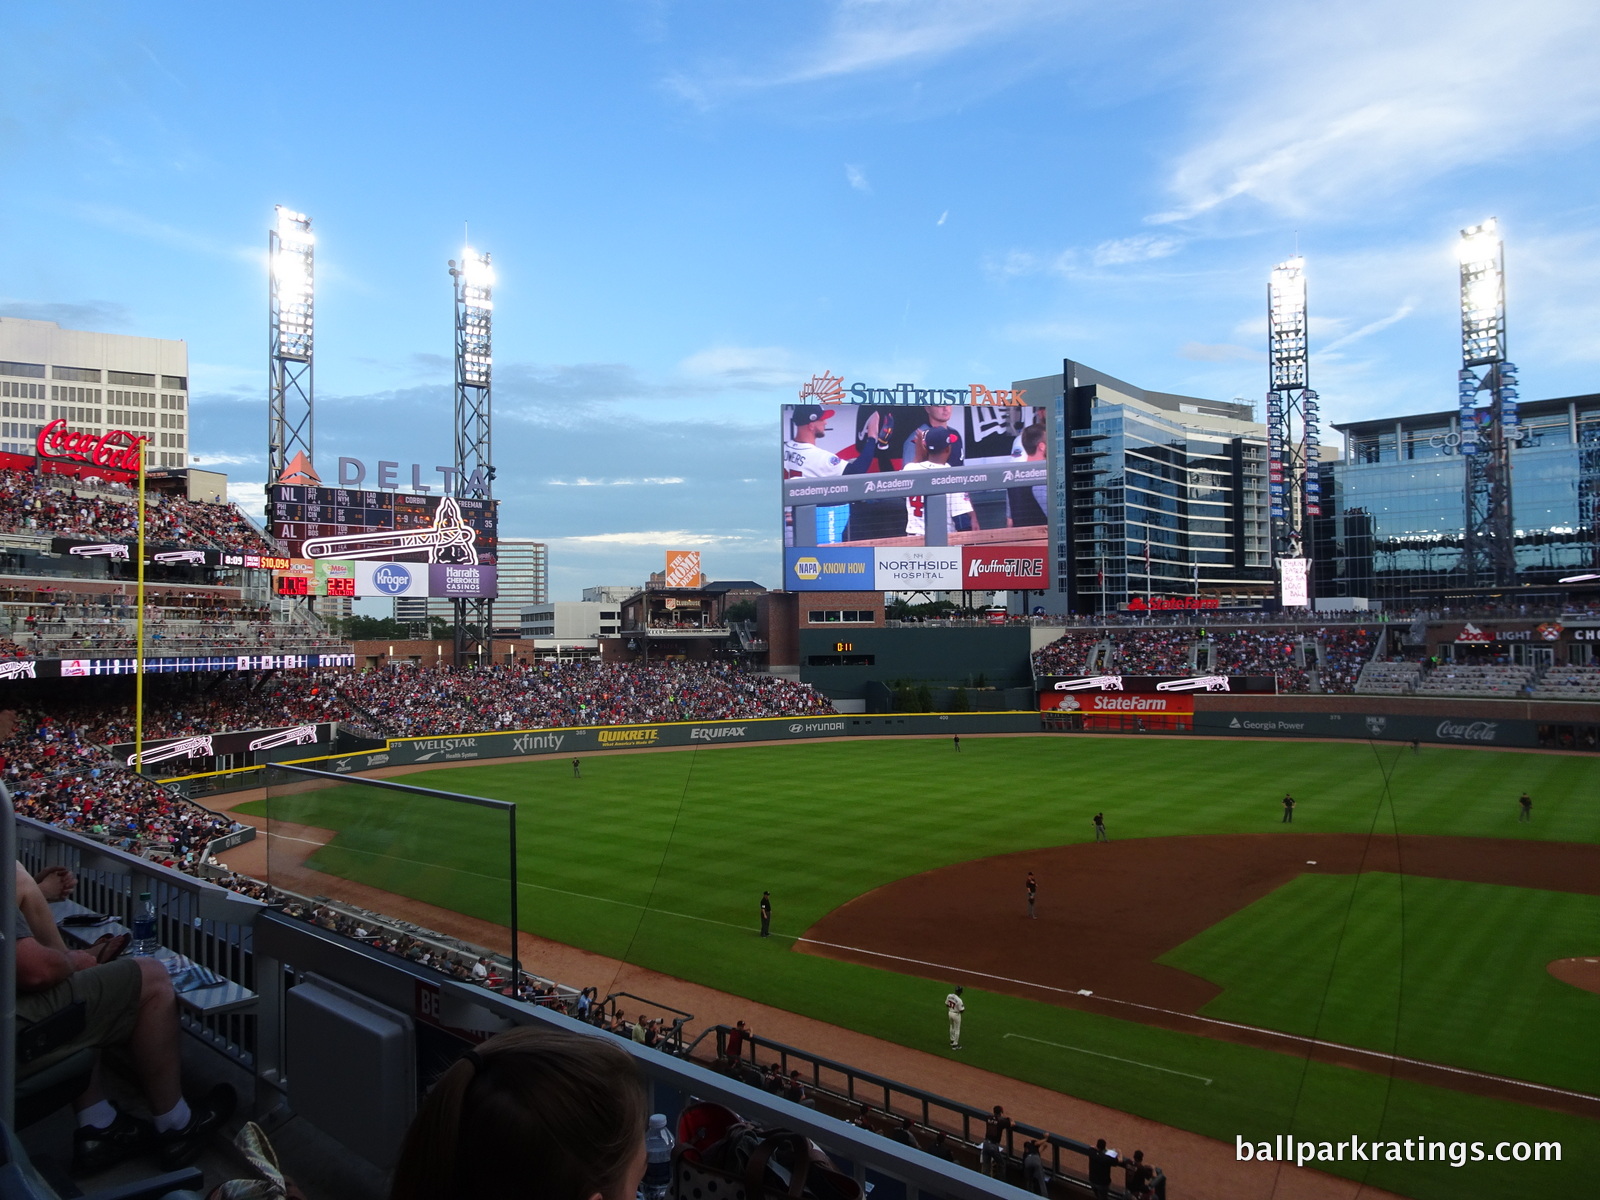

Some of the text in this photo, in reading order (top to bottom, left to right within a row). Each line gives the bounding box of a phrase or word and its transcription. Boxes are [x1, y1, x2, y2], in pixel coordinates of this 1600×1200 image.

[37, 419, 147, 471] Coca-Cola
[338, 457, 490, 496] DELTA
[931, 474, 987, 485] academy.com
[876, 479, 914, 489] Academy
[281, 487, 298, 501] NL
[789, 485, 849, 497] academy.com
[405, 497, 426, 505] CORBIN
[458, 501, 482, 509] FREEMAN
[484, 520, 492, 528] 35
[282, 524, 298, 538] AL
[225, 555, 243, 566] 8:09
[261, 556, 290, 569] $10,094
[670, 554, 685, 570] THE
[798, 562, 866, 574] NAPA KNOW HOW
[879, 561, 958, 570] NORTHSIDE
[969, 559, 1043, 577] Kauffman TIRE
[446, 567, 480, 578] Harrah's
[666, 551, 700, 587] HOME
[680, 564, 700, 587] DEPOT
[284, 577, 306, 590] 172
[328, 578, 354, 590] 232
[377, 568, 409, 592] Kroger
[1148, 596, 1220, 610] StateFarm
[1496, 630, 1532, 640] LIGHT
[148, 660, 158, 672] 4
[165, 659, 174, 672] 5
[181, 658, 190, 672] 6
[198, 658, 206, 671] 7
[212, 658, 220, 670] 8
[228, 658, 235, 670] 9
[1094, 696, 1166, 710] StateFarm
[806, 722, 844, 732] HYUNDAI
[1243, 720, 1304, 730] Georgia Power
[1436, 720, 1497, 740] Coca-Cola
[598, 729, 659, 742] QUIKRETE
[690, 727, 746, 740] EQUIFAX
[414, 738, 477, 750] WELLSTAR
[513, 733, 564, 754] xfinity
